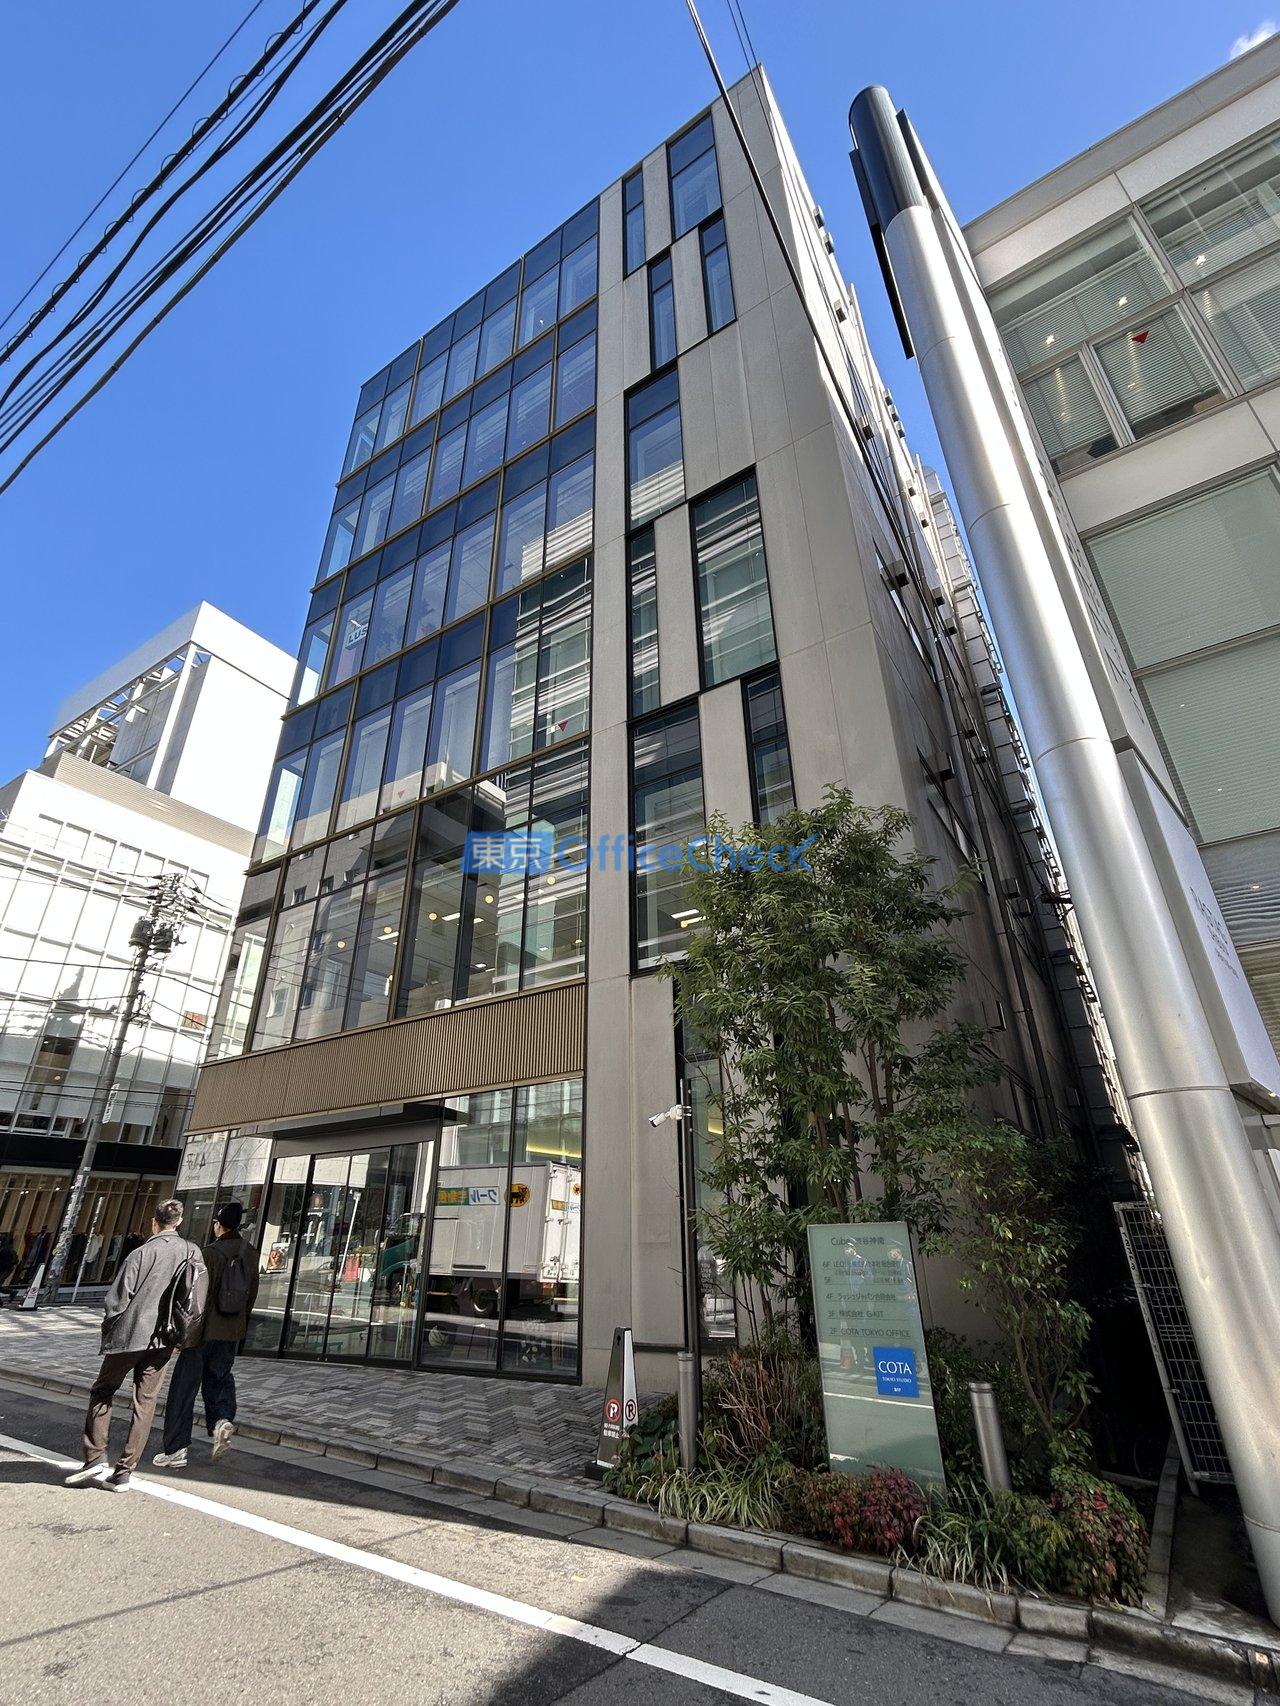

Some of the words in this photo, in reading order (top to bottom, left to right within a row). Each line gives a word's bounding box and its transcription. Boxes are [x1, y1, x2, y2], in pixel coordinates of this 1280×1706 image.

[829, 1327, 838, 1335] 2F
[840, 1328, 860, 1337] COTA
[861, 1328, 885, 1338] TOKYO
[885, 1329, 912, 1339] OFFICE
[877, 1360, 913, 1375] COTA
